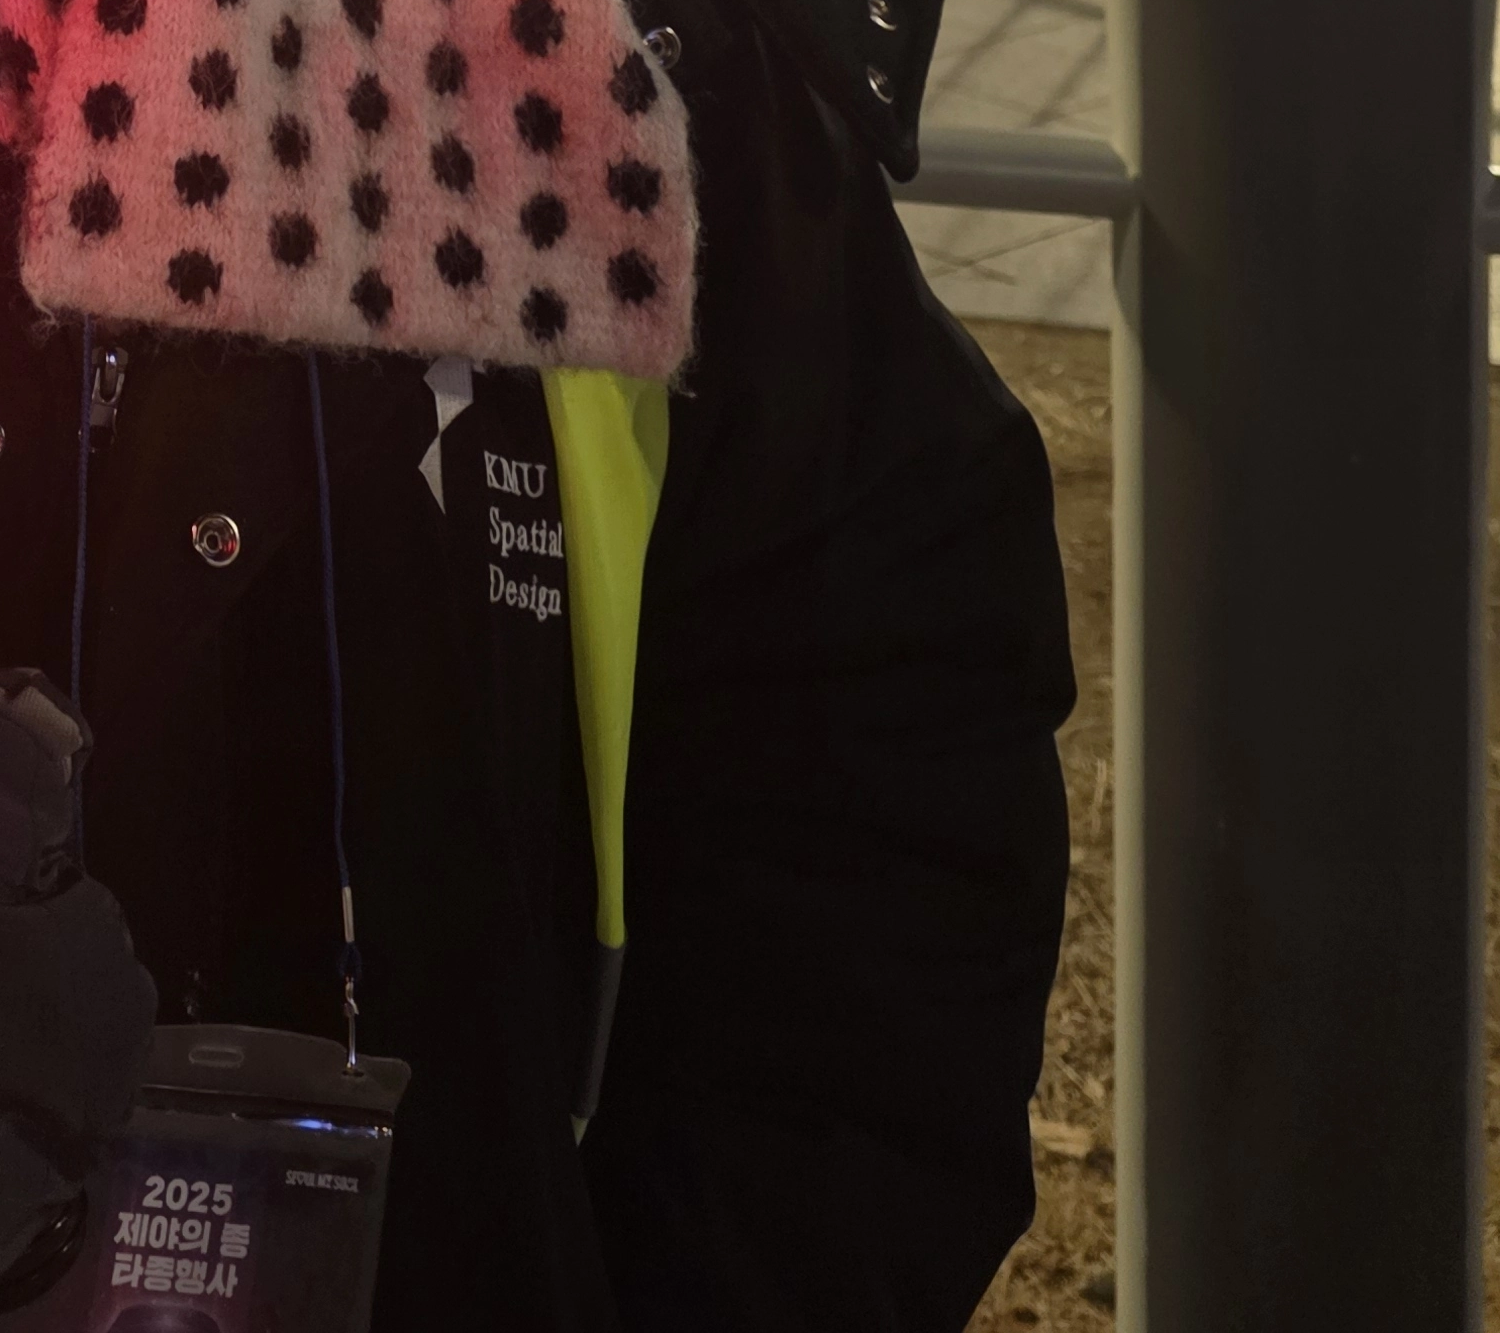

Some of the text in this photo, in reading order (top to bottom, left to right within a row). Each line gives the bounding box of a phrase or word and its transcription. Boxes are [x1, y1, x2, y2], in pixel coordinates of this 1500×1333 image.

[484, 450, 547, 498] KMU
[489, 506, 563, 557] Spatial
[489, 564, 562, 622] Design
[142, 1175, 234, 1216] 2025
[113, 1211, 251, 1259] 제야의 종
[111, 1252, 239, 1298] 타종행사
